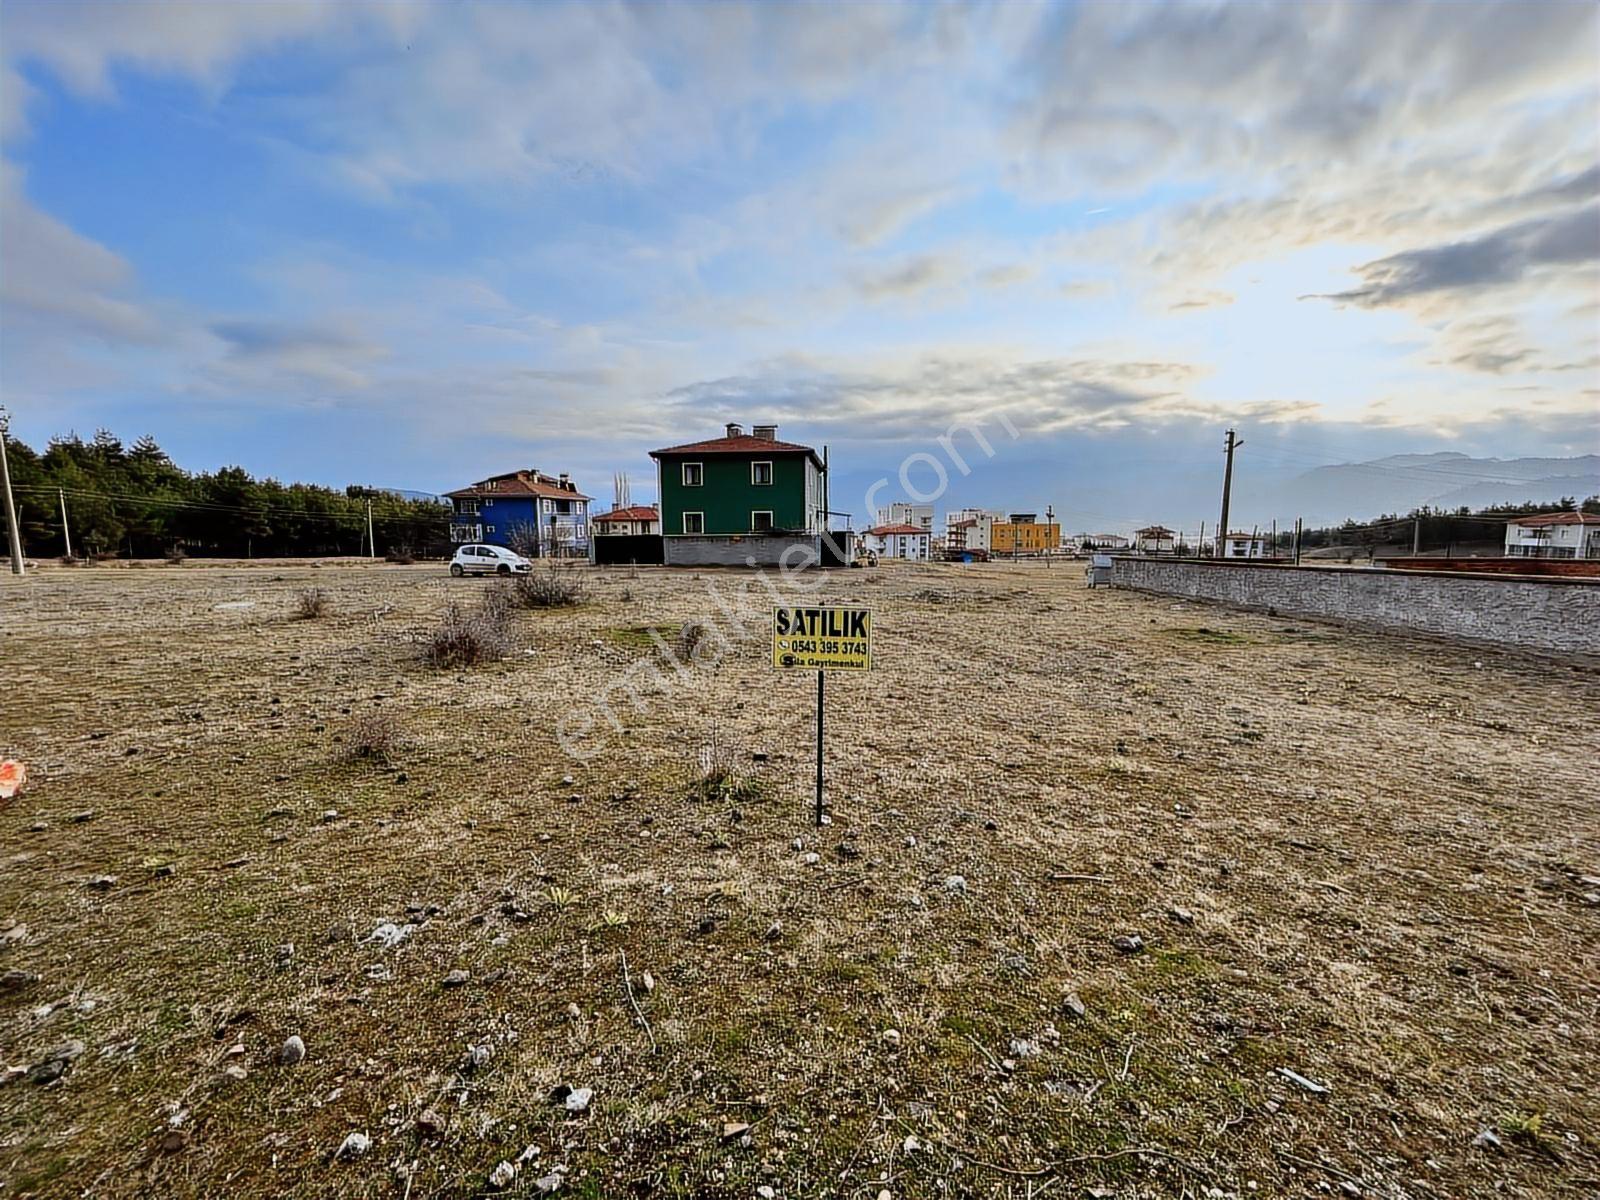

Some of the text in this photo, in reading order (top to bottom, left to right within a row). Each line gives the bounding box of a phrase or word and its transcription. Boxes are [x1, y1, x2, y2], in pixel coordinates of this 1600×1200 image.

[776, 609, 868, 638] SATILIK
[791, 640, 867, 655] 0543 395 3743
